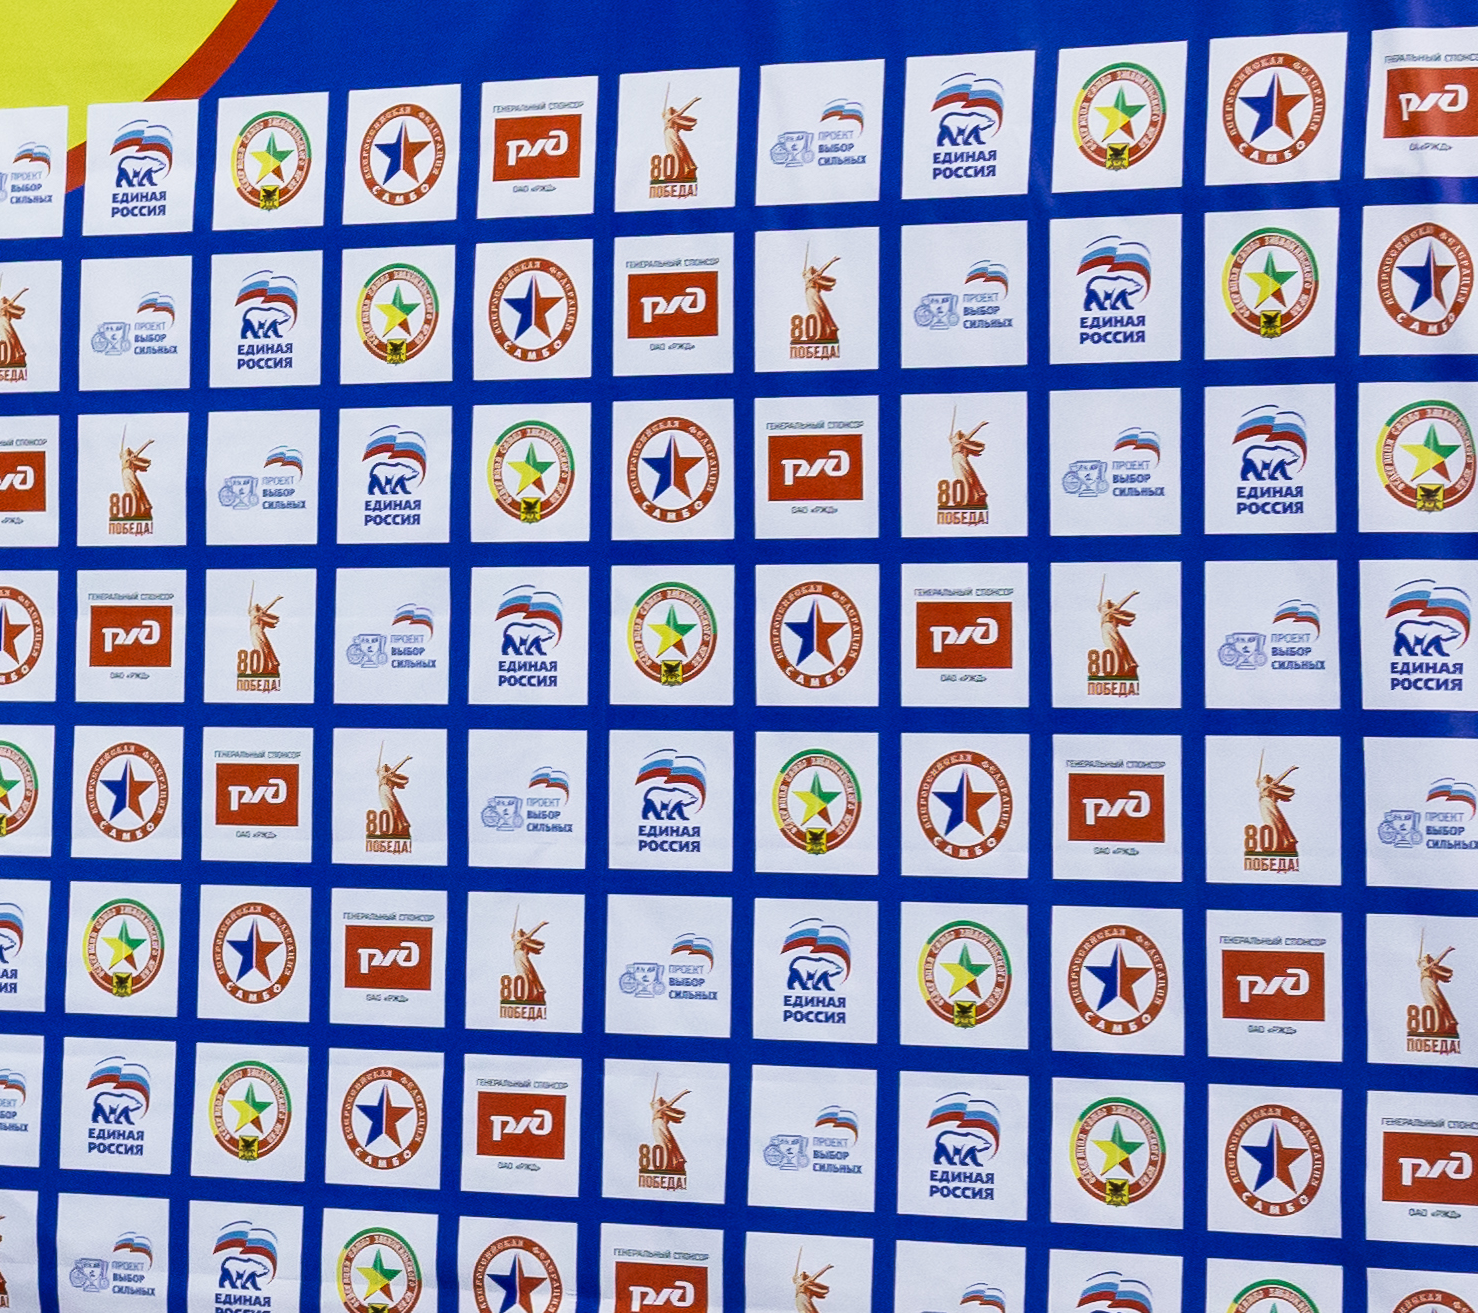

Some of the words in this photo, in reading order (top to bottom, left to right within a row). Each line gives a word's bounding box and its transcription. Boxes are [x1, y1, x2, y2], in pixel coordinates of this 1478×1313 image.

[818, 130, 854, 141] ПРОЕКТ
[818, 143, 855, 153] ВЫБОР
[1237, 137, 1309, 163] САМБО
[818, 155, 866, 166] СИЛЬНЫХ
[933, 150, 997, 166] ЕДИНАЯ
[933, 165, 996, 179] РОССИЯ
[112, 191, 166, 204] ЕДИНАЯ
[372, 181, 431, 205] САМБО
[649, 181, 698, 200] ПОБЕДА!
[111, 205, 166, 217] РОССИЯ
[963, 293, 999, 303] ПРОЕКТ
[964, 306, 1000, 316] ВЫБОР
[963, 318, 1013, 329] СИЛЬНЫХ
[1080, 315, 1146, 330] ЕДИНАЯ
[1080, 330, 1145, 345] РОССИЯ
[238, 343, 293, 356] ЕДИНАЯ
[503, 336, 564, 359] САМБО
[790, 344, 840, 360] ПОБЕДА!
[238, 357, 292, 370] РОССИЯ
[1112, 460, 1150, 471] ПРОЕКТ
[1113, 474, 1151, 483] ВЫБОР
[1113, 487, 1165, 497] СИЛЬНЫХ
[1237, 486, 1303, 500] ЕДИНАЯ
[365, 500, 421, 512] ЕДИНАЯ
[642, 498, 706, 521] САМБО
[1237, 501, 1304, 515] РОССИЯ
[365, 514, 420, 526] РОССИЯ
[937, 509, 988, 526] ПОБЕДА!
[109, 522, 153, 536] ПОБЕДА!
[1271, 632, 1311, 643] ПРОЕКТ
[1272, 645, 1312, 656] ВЫБОР
[499, 661, 557, 673] ЕДИНАЯ
[1271, 658, 1326, 670] СИЛЬНЫХ
[1390, 661, 1464, 675] ЕДИНАЯ
[499, 675, 557, 687] РОССИЯ
[785, 663, 849, 685] САМБО
[237, 677, 281, 692] ПОБЕДА!
[1088, 680, 1139, 697] ПОБЕДА!
[1390, 677, 1464, 691] РОССИЯ
[98, 818, 155, 839] САМБО
[639, 826, 700, 839] ЕДИНАЯ
[366, 838, 412, 854] ПОБЕДА!
[639, 840, 700, 853] РОССИЯ
[932, 833, 998, 856] САМБО
[1245, 855, 1299, 874] ПОБЕДА!
[665, 964, 704, 974] ПРОЕКТ
[666, 977, 705, 987] ВЫБОР
[226, 979, 283, 1001] САМБО
[665, 990, 718, 1000] СИЛЬНЫХ
[784, 995, 846, 1010] ЕДИНАЯ
[500, 1004, 547, 1021] ПОБЕДА!
[783, 1010, 846, 1024] РОССИЯ
[1084, 1008, 1153, 1033] САМБО
[1407, 1037, 1461, 1055] ПОБЕДА!
[88, 1128, 144, 1142] ЕДИНАЯ
[88, 1142, 143, 1156] РОССИЯ
[353, 1144, 413, 1167] САМБО
[639, 1173, 687, 1191] ПОБЕДА!
[930, 1170, 994, 1185] ЕДИНАЯ
[930, 1185, 994, 1200] РОССИЯ
[1241, 1188, 1309, 1214] САМБО
[215, 1293, 271, 1308] ЕДИНАЯ
